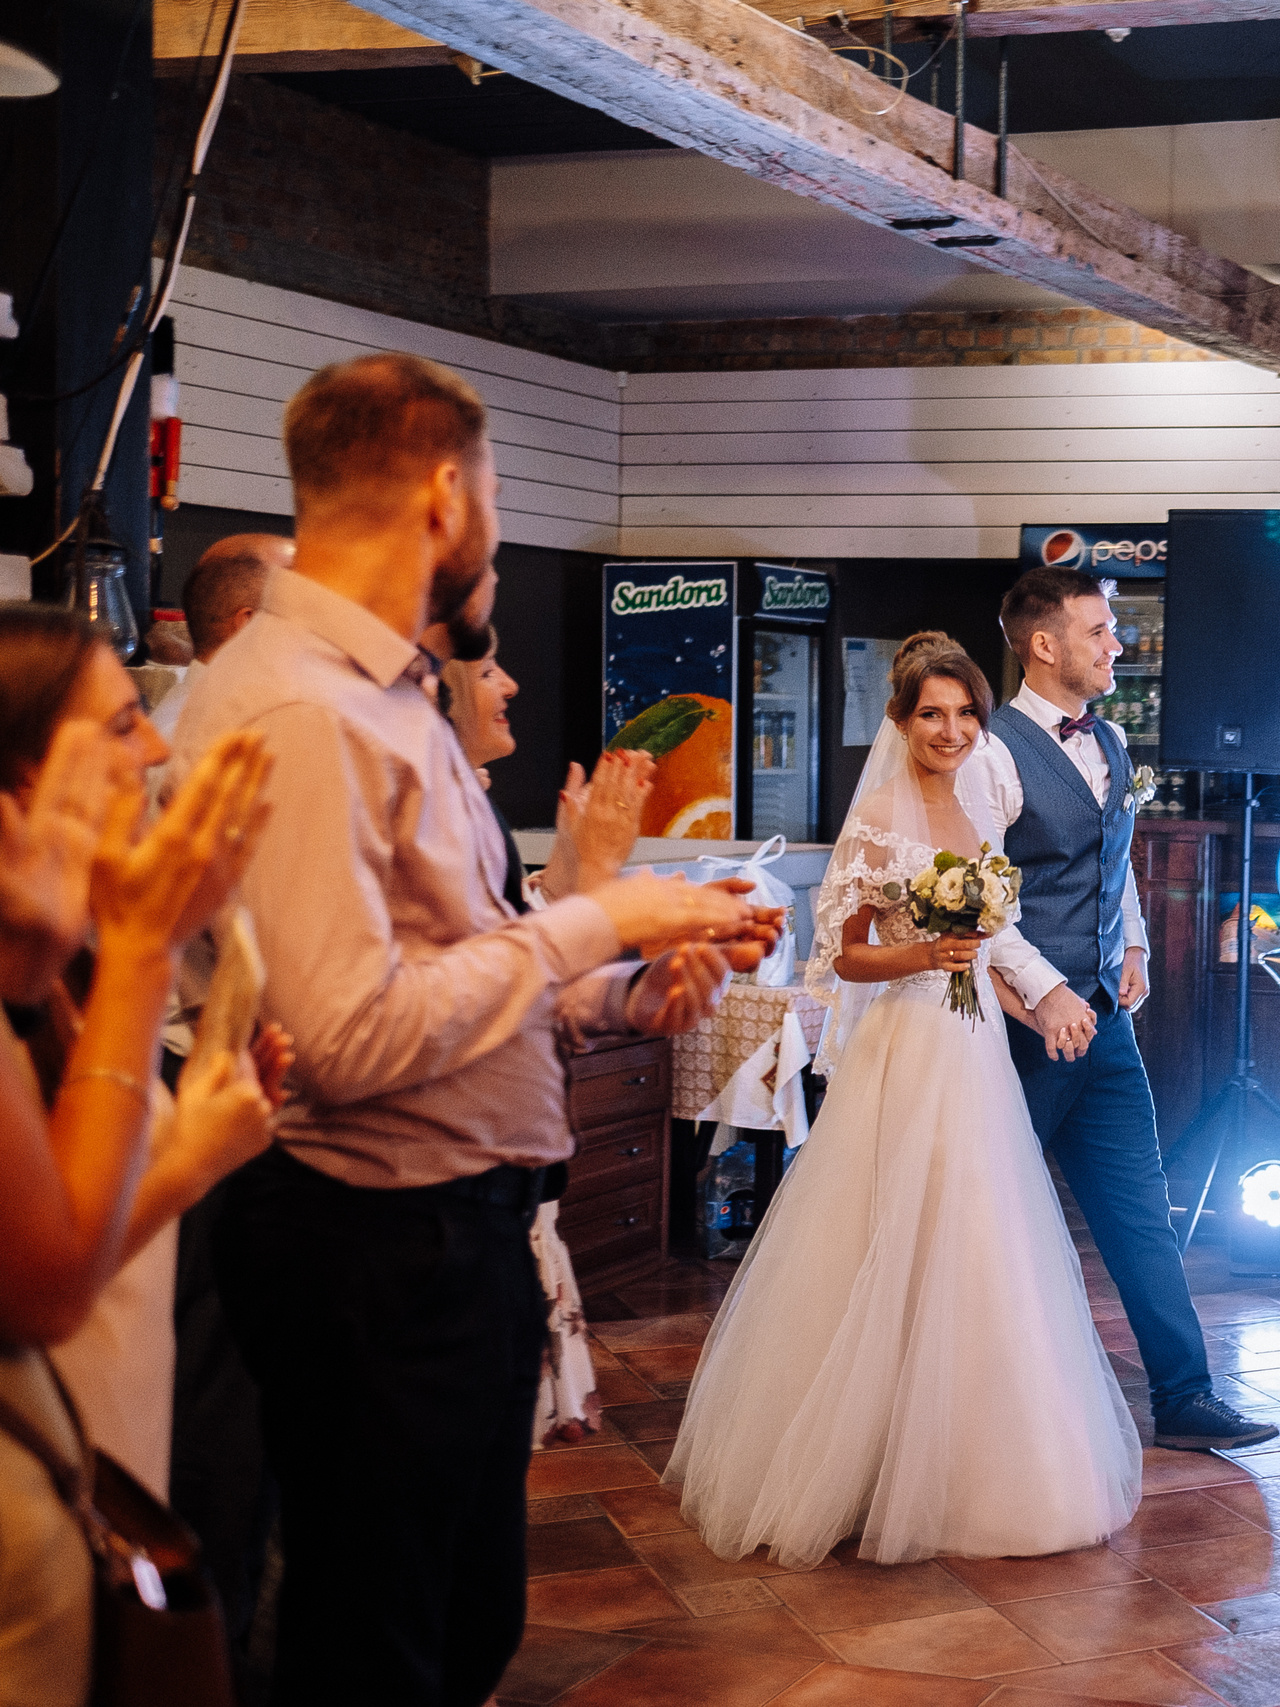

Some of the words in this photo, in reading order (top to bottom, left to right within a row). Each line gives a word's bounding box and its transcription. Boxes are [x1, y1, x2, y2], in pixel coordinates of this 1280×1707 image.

[1091, 538, 1169, 566] peps
[612, 576, 727, 614] Sandora
[762, 574, 829, 610] Sandora
